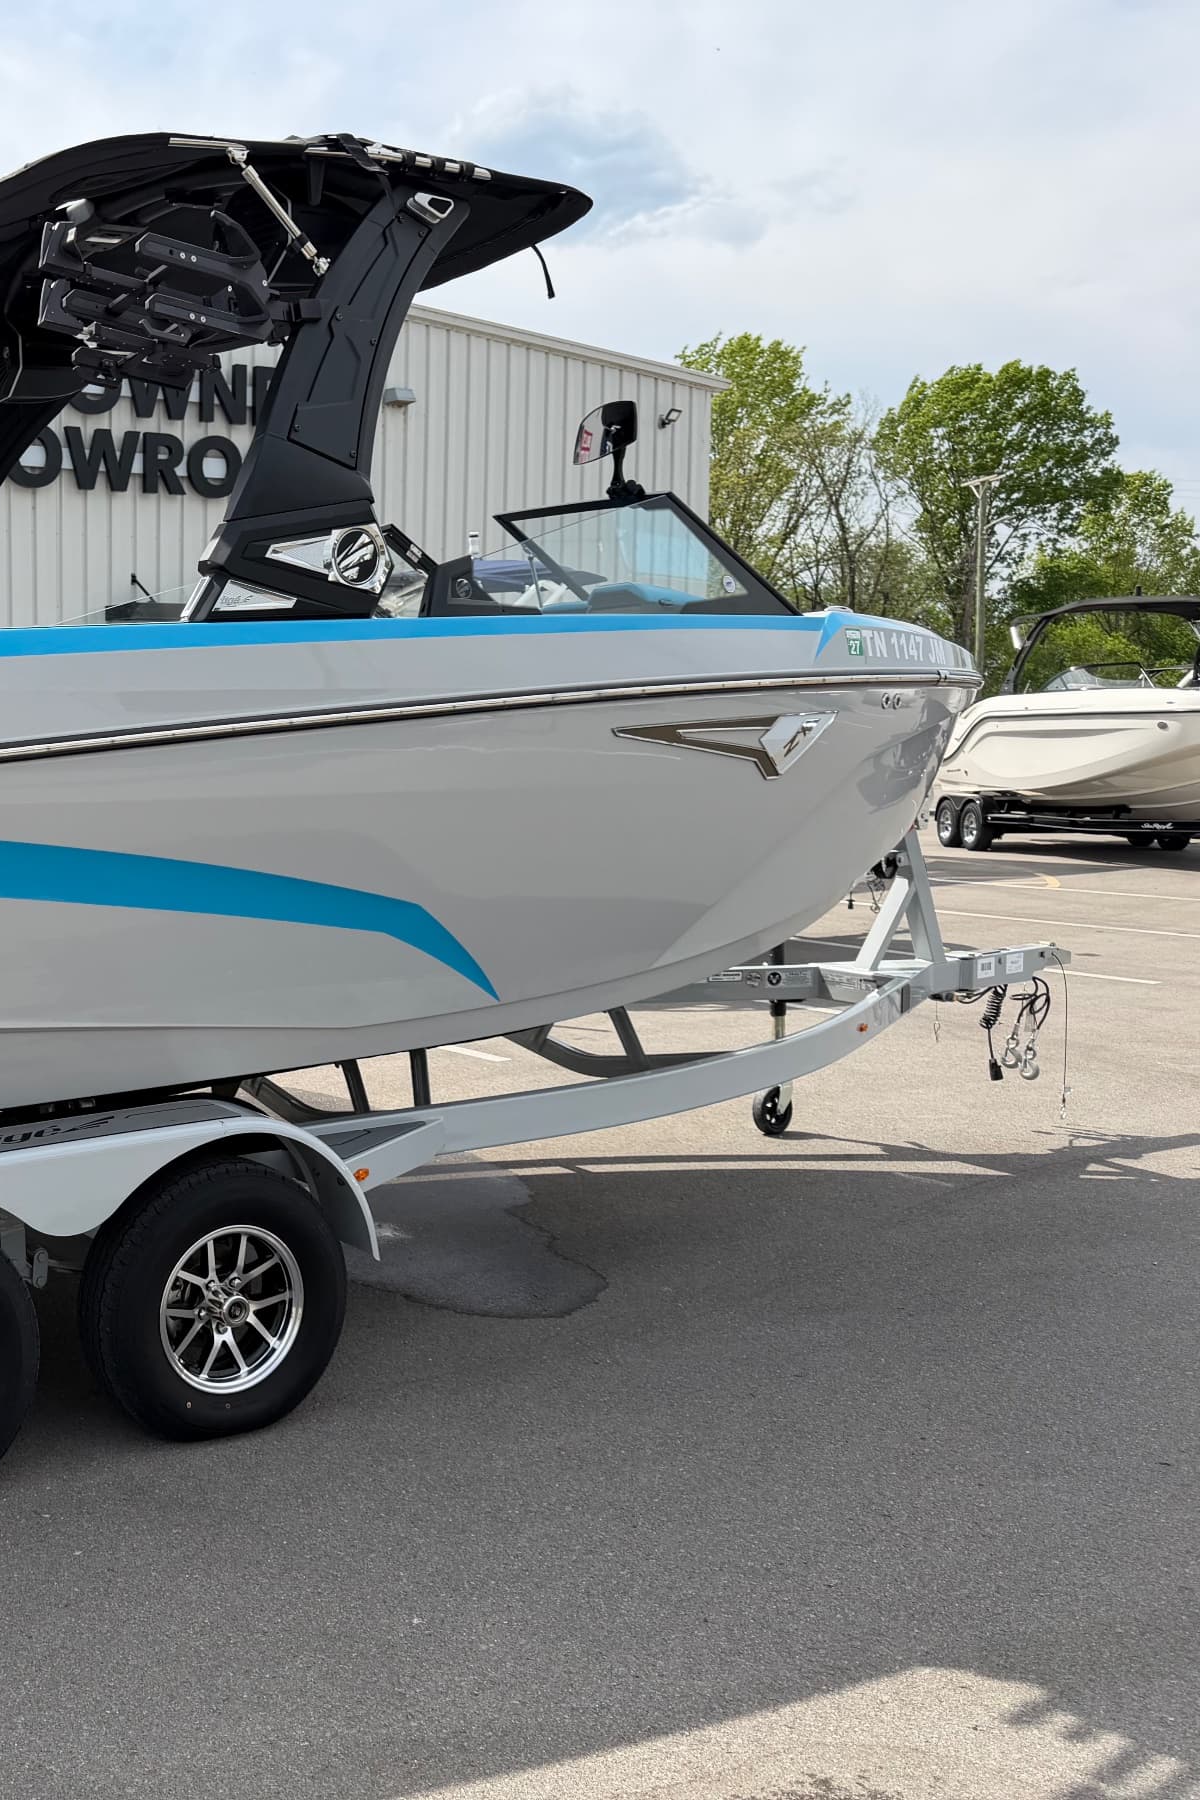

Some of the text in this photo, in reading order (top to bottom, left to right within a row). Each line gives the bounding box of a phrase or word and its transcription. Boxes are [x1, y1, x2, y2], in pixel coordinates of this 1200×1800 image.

[848, 640, 860, 655] 27
[861, 629, 888, 658] TN
[891, 632, 924, 662] 1147
